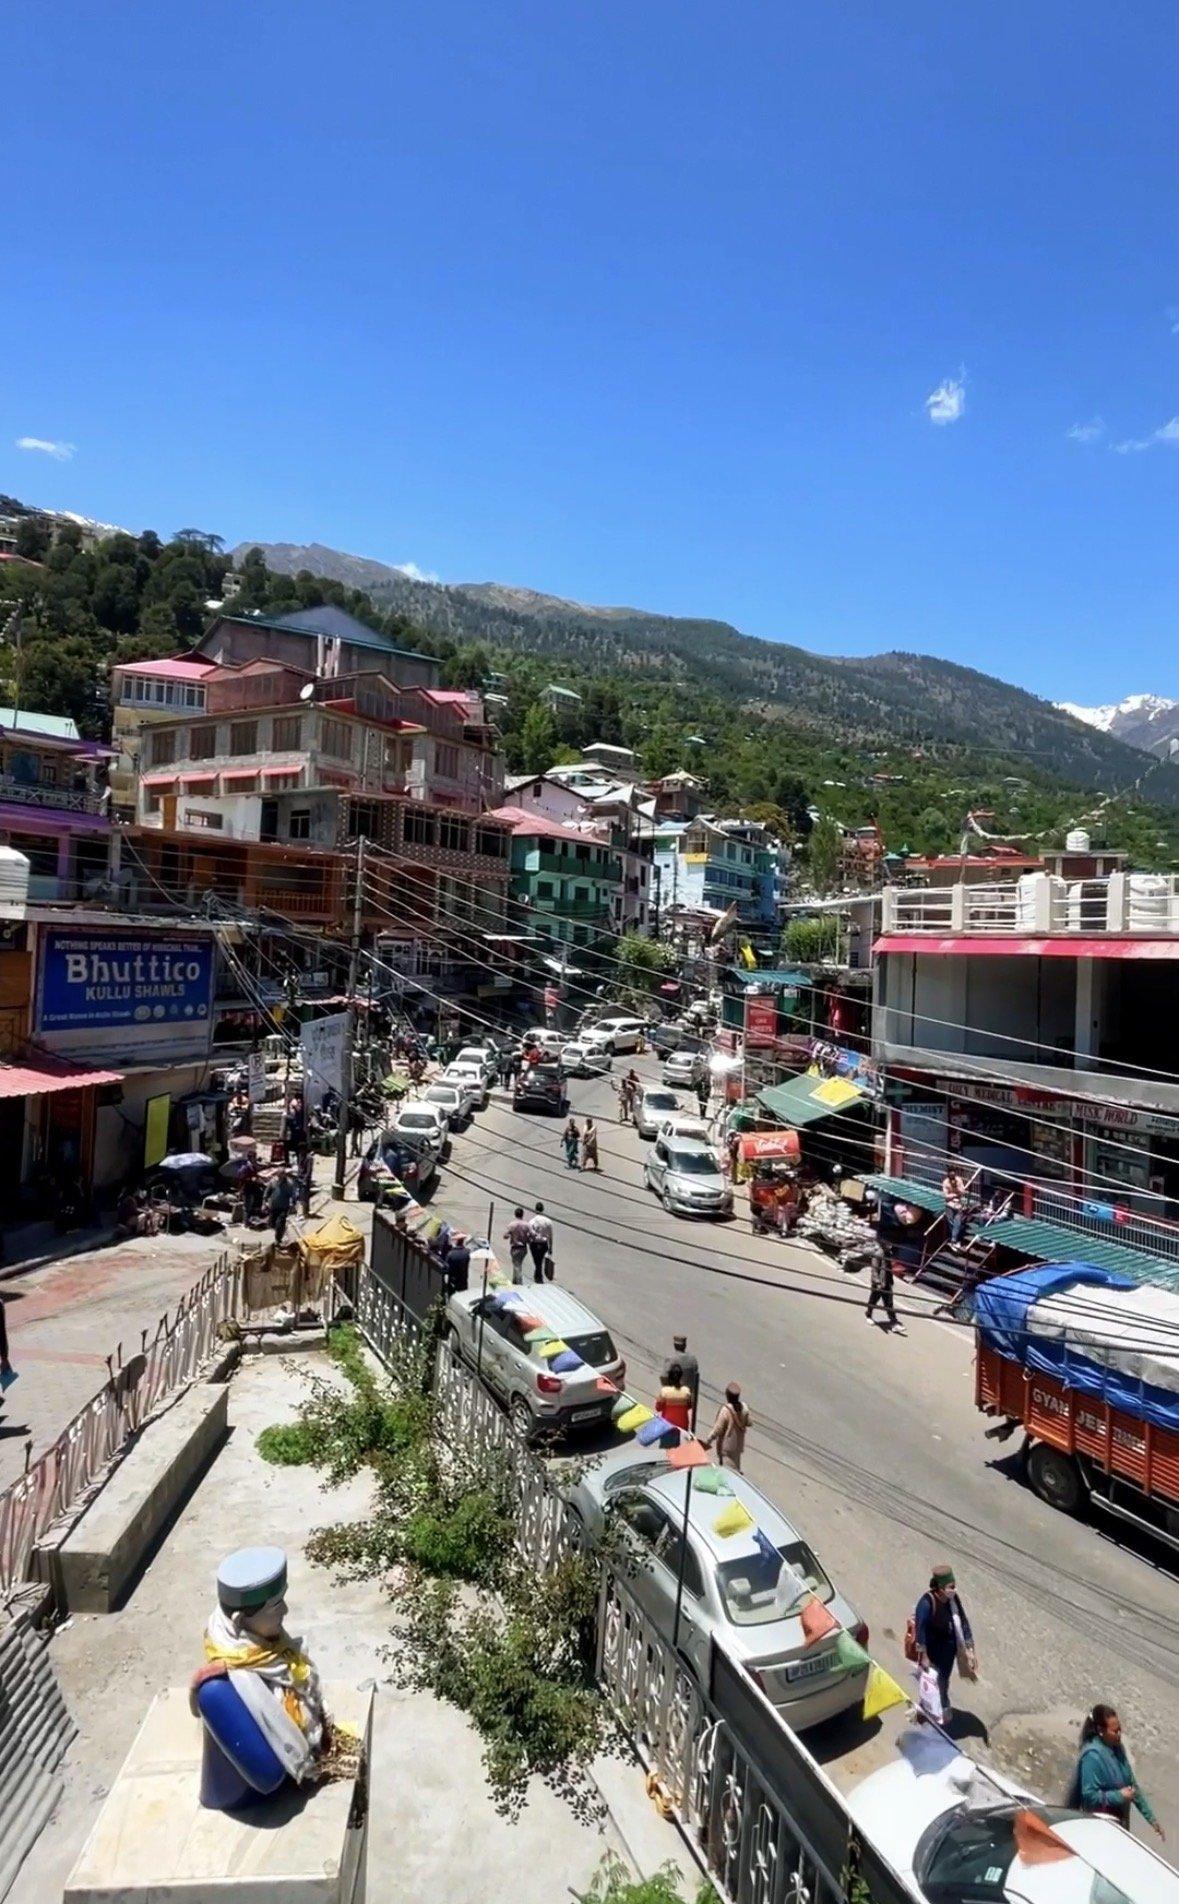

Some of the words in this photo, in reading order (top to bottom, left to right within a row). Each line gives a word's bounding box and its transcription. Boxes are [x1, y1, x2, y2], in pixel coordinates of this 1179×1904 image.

[65, 954, 200, 983] Bhuttico
[85, 986, 131, 1001] KULLU
[135, 984, 185, 998] SHAWLS
[1104, 1108, 1138, 1125] WORLD
